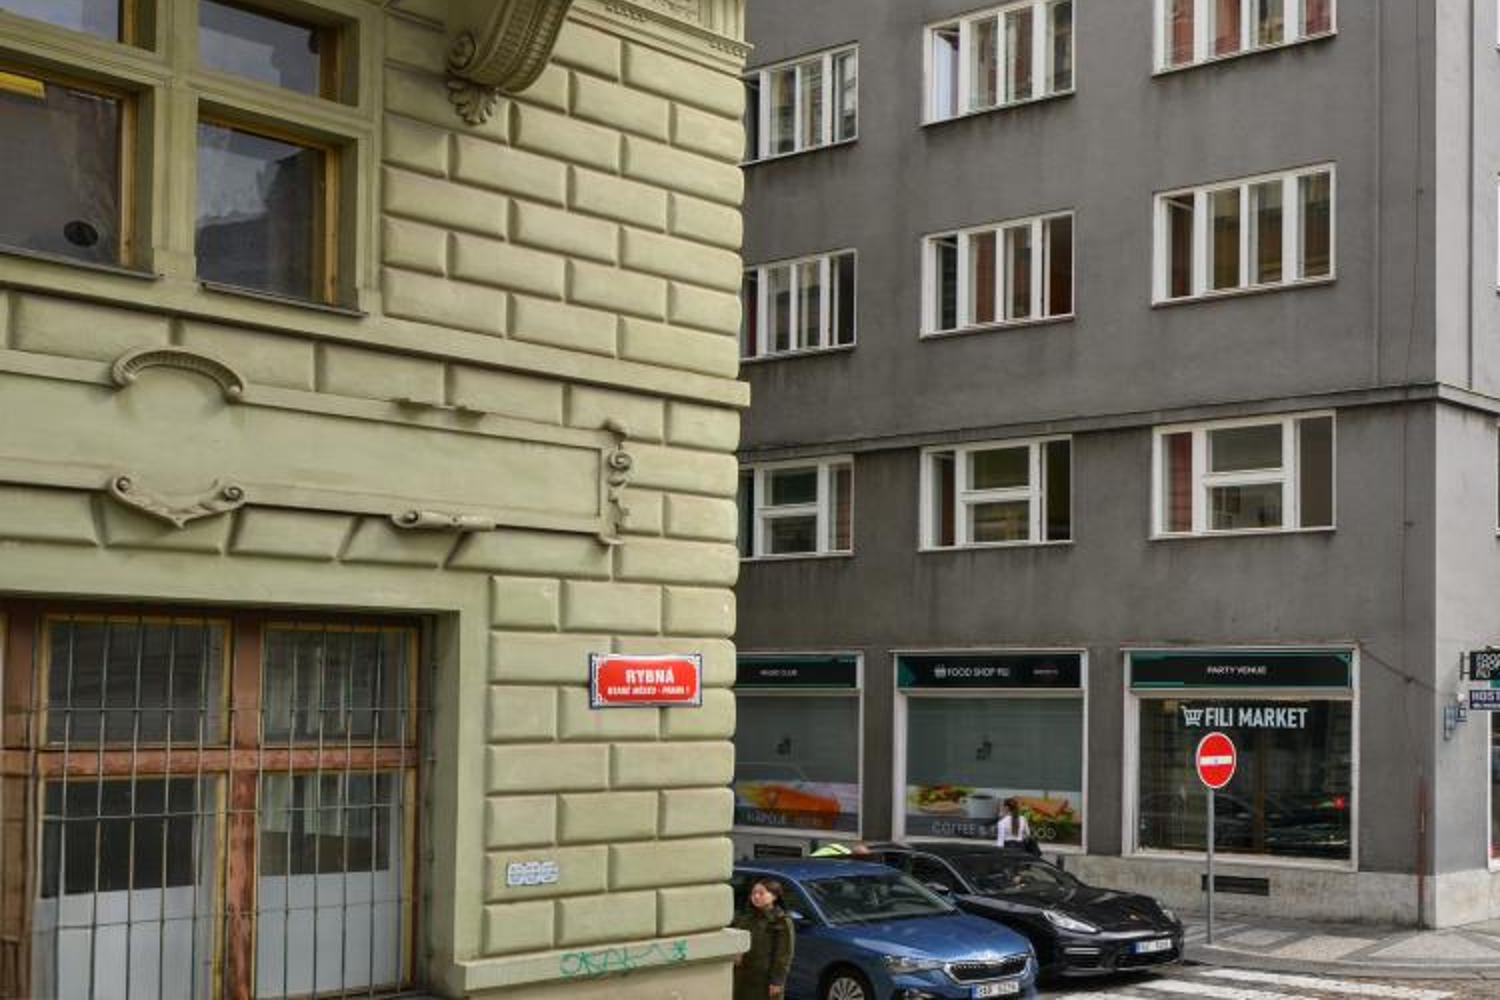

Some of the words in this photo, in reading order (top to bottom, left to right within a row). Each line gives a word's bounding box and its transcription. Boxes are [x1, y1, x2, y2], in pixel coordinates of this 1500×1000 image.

[947, 667, 972, 677] FOOD
[1204, 707, 1233, 727] FILI
[1238, 707, 1308, 728] MARKET
[931, 821, 975, 835] COFFEE
